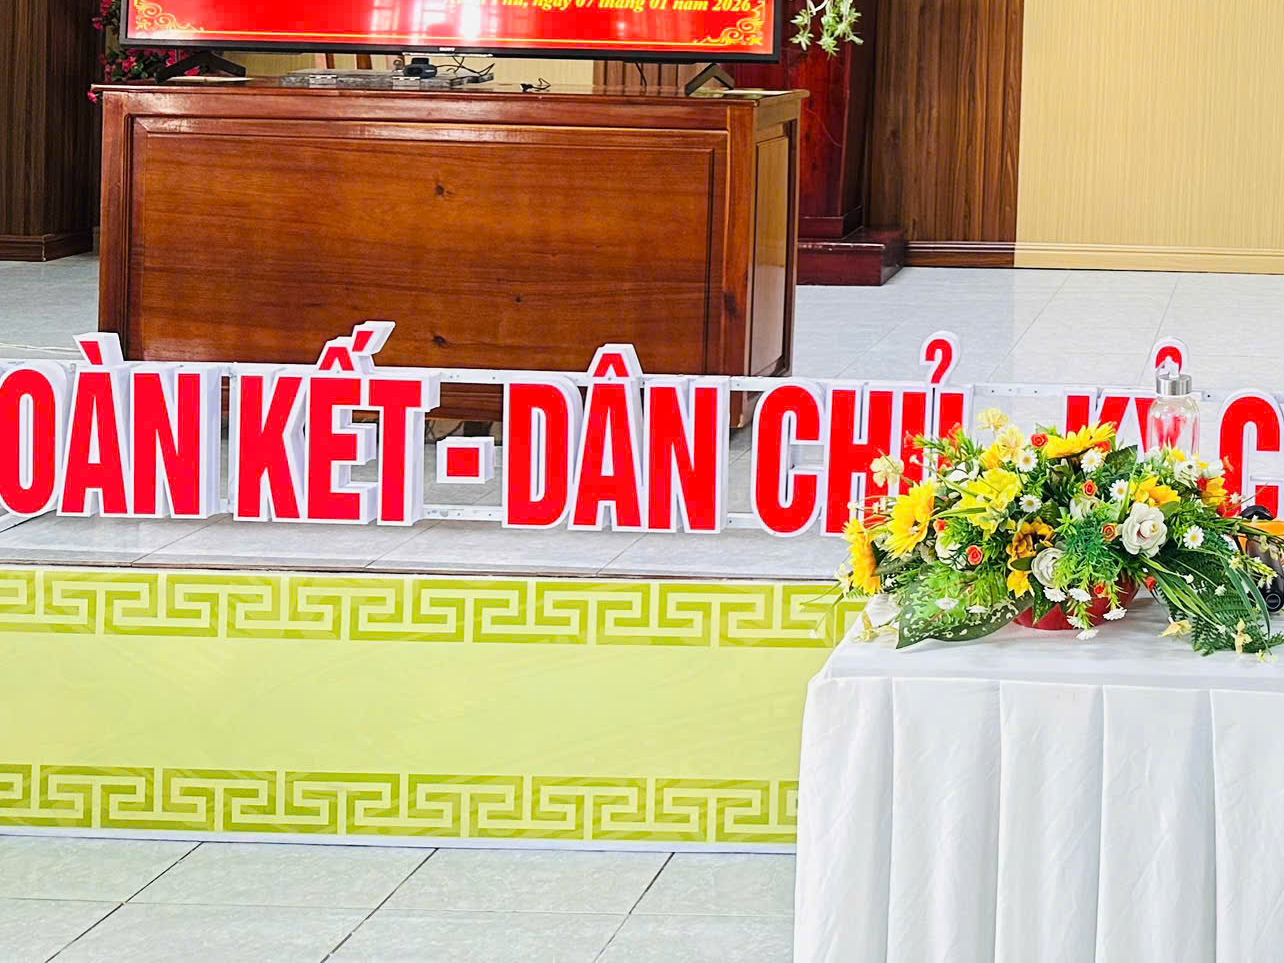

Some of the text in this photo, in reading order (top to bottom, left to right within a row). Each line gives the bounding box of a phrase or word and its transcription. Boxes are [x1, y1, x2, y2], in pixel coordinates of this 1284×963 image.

[0, 342, 200, 514] OÀN
[238, 331, 421, 521] KẾT
[508, 354, 716, 529] DÂN
